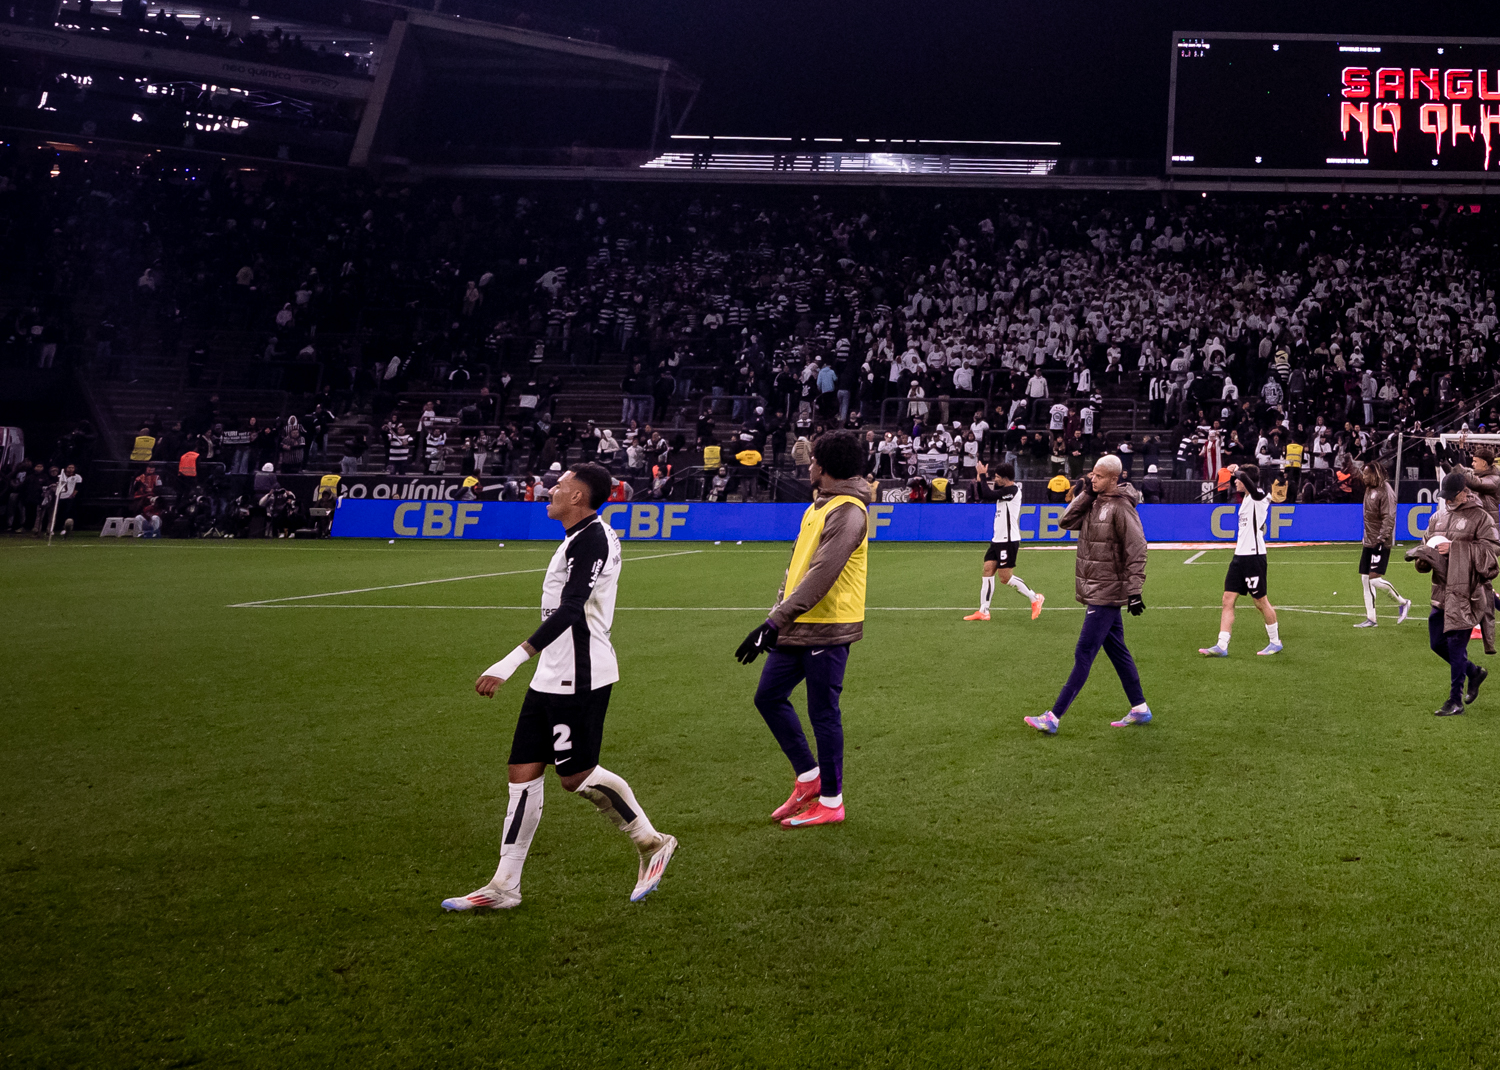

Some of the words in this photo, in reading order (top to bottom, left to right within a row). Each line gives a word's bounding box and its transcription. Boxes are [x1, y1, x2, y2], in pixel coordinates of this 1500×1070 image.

[1340, 102, 1402, 148] NO
[393, 502, 483, 537] CBF
[601, 504, 690, 538] CBF
[1211, 505, 1296, 539] CF
[1244, 575, 1260, 589] 27
[553, 723, 573, 751] 2
